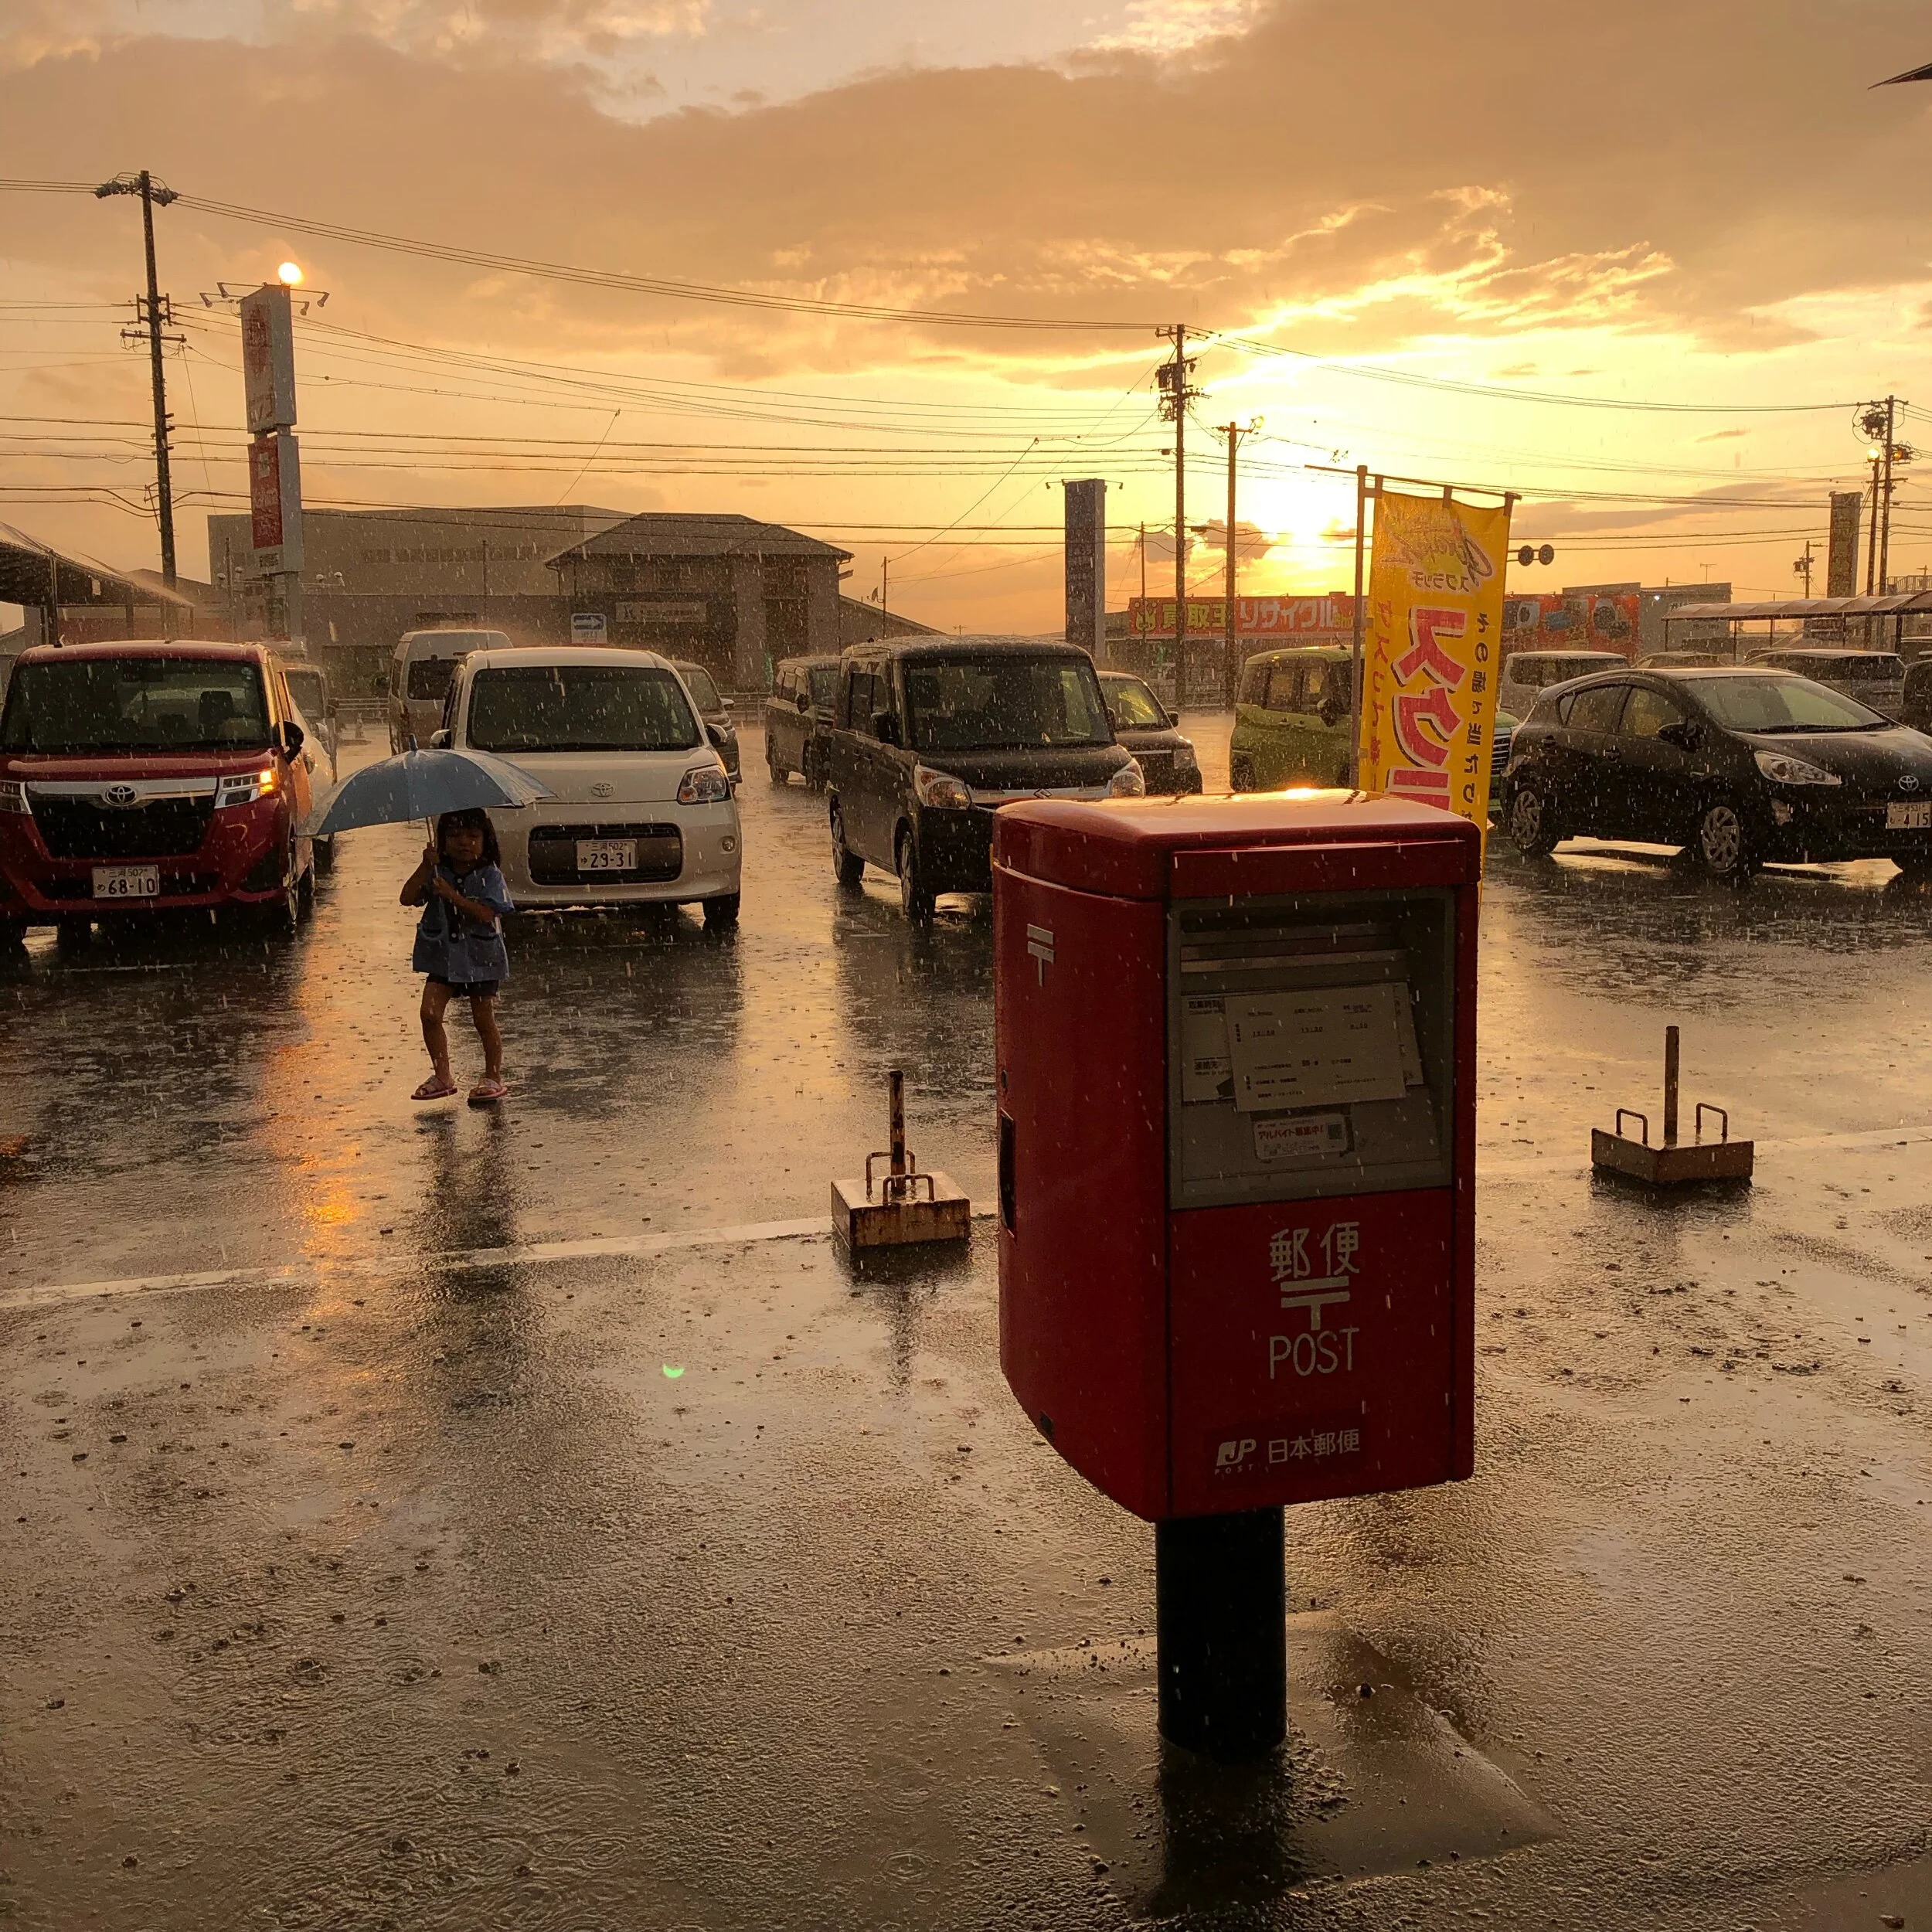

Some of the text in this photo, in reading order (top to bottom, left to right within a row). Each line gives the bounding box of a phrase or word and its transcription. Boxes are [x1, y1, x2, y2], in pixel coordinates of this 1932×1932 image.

[1239, 599, 1338, 629] リサイクル
[590, 852, 632, 868] 29-31
[108, 879, 155, 894] 68-10
[1269, 1221, 1360, 1282] 郵便
[1269, 1326, 1360, 1379] POST
[1268, 1429, 1360, 1464] 日本郵便
[1214, 1464, 1254, 1475] POST
